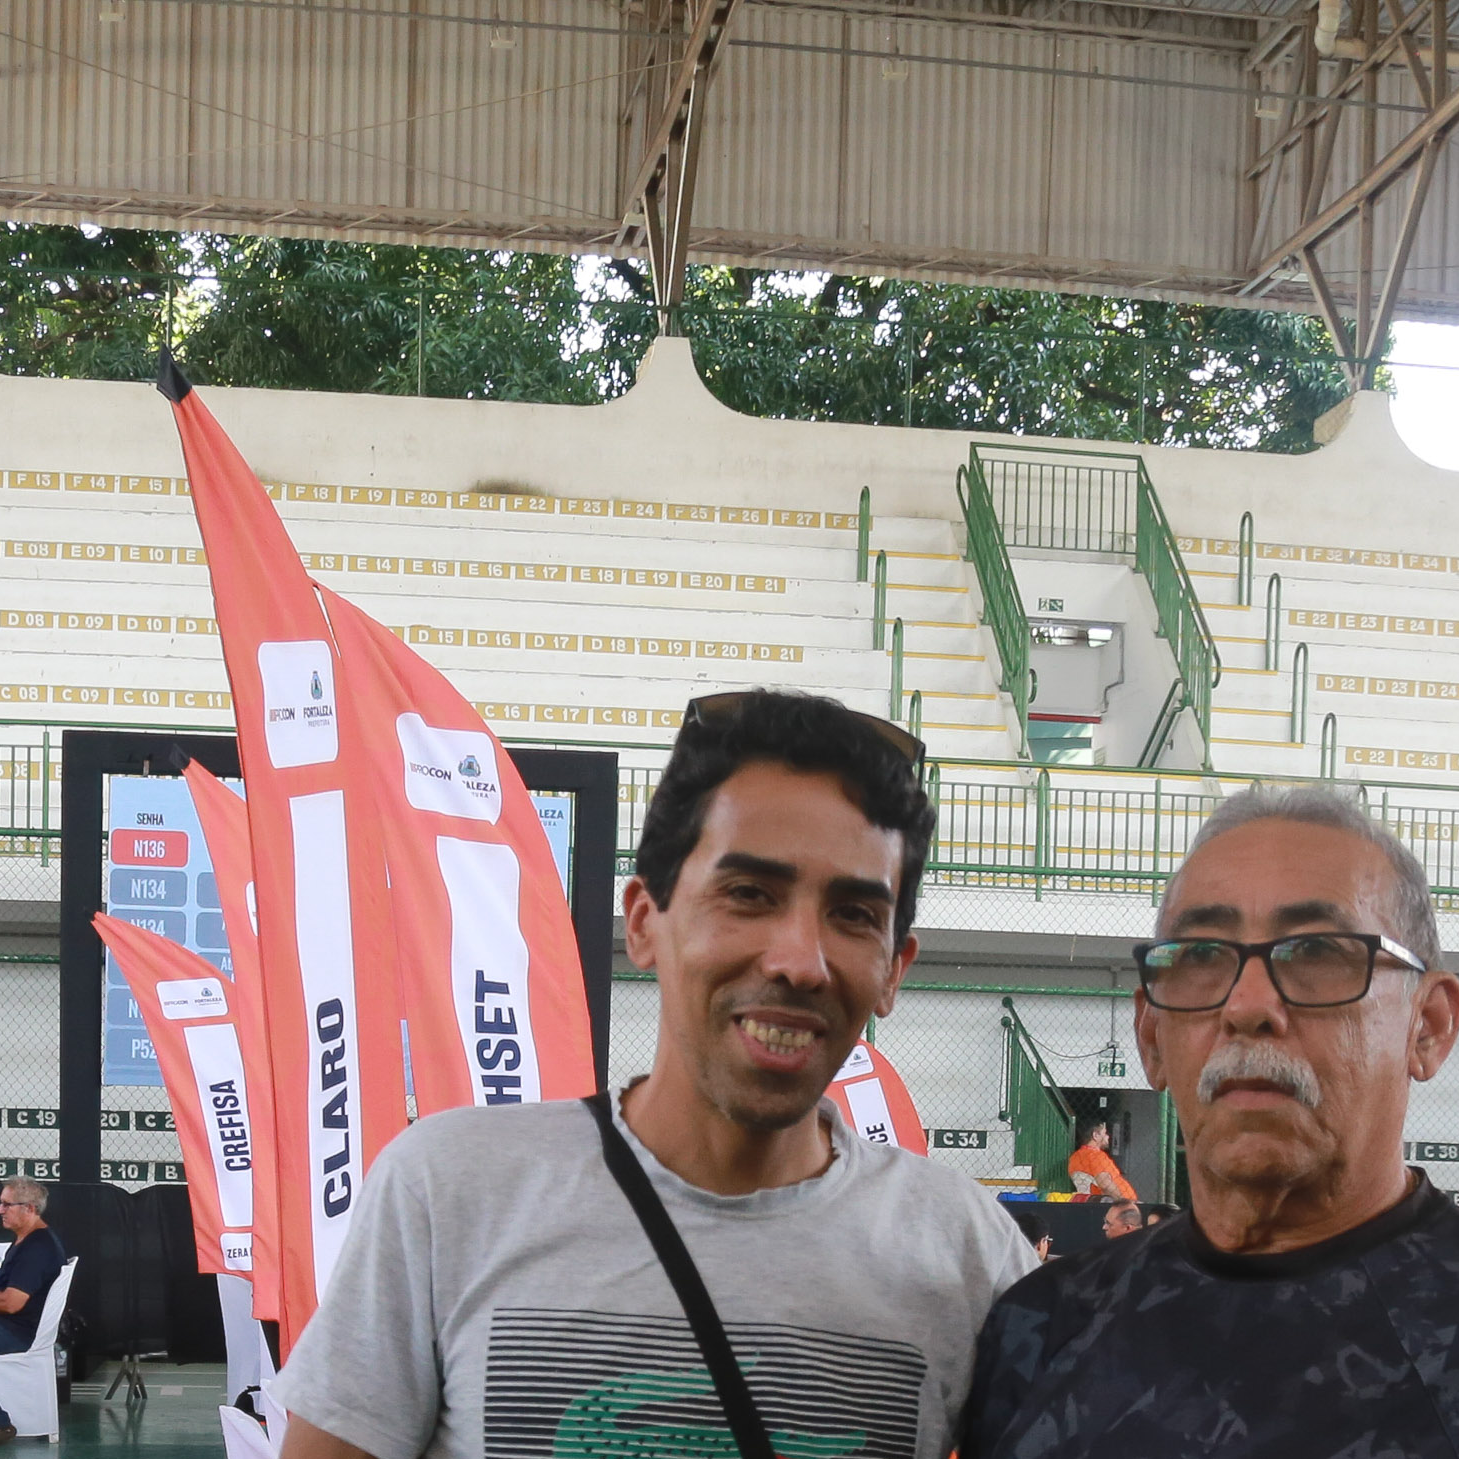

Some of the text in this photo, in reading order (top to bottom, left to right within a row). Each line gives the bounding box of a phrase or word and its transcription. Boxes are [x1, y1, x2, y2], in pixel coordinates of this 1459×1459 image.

[128, 477, 163, 492] F 15
[404, 490, 438, 505] F 20
[780, 511, 814, 526] F 27
[129, 547, 165, 562] E 10
[468, 562, 503, 577] E 16
[744, 577, 779, 592] E 21
[126, 617, 163, 632] D 10
[1296, 611, 1328, 626] E 22
[476, 632, 512, 647] D 16
[591, 637, 627, 653] D 18
[760, 646, 795, 661] D 21
[1324, 676, 1356, 691] D 22
[62, 689, 100, 704] C 09
[303, 706, 333, 719] FORTALEZA
[484, 704, 521, 719] C 16
[602, 710, 638, 725] C 18
[1353, 749, 1386, 764] C 22
[417, 763, 452, 781] PROCON
[464, 780, 496, 793] ALEZA
[136, 813, 164, 826] SENHA
[133, 839, 165, 859] N136
[131, 878, 166, 900] N134
[316, 998, 352, 1219] CLARO
[16, 1110, 57, 1126] C 19
[210, 1079, 253, 1172] CREFISA
[943, 1132, 980, 1147] C 34
[227, 1248, 248, 1259] ZERA
